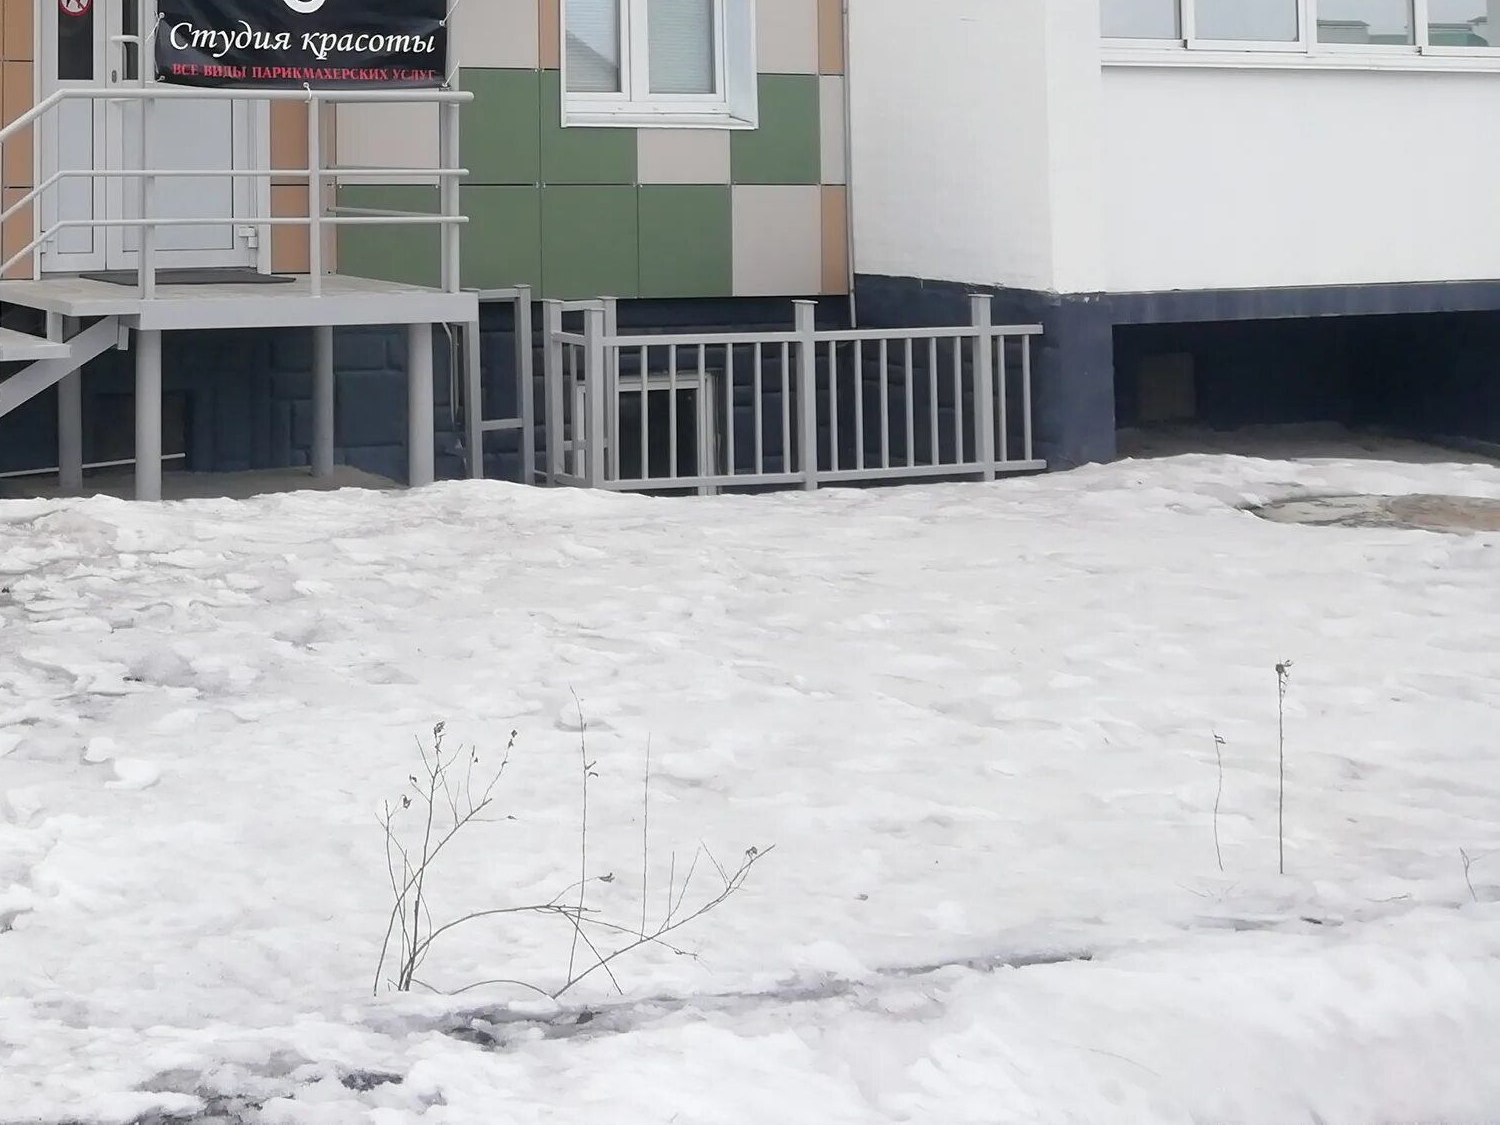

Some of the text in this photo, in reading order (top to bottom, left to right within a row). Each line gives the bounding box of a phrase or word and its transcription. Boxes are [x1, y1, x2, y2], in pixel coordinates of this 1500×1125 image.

[169, 20, 436, 61] Студия красоты
[172, 63, 436, 82] ВСЕ ВИДЫ ПАРИКМАХЕРСКИХ УСЛУГ
